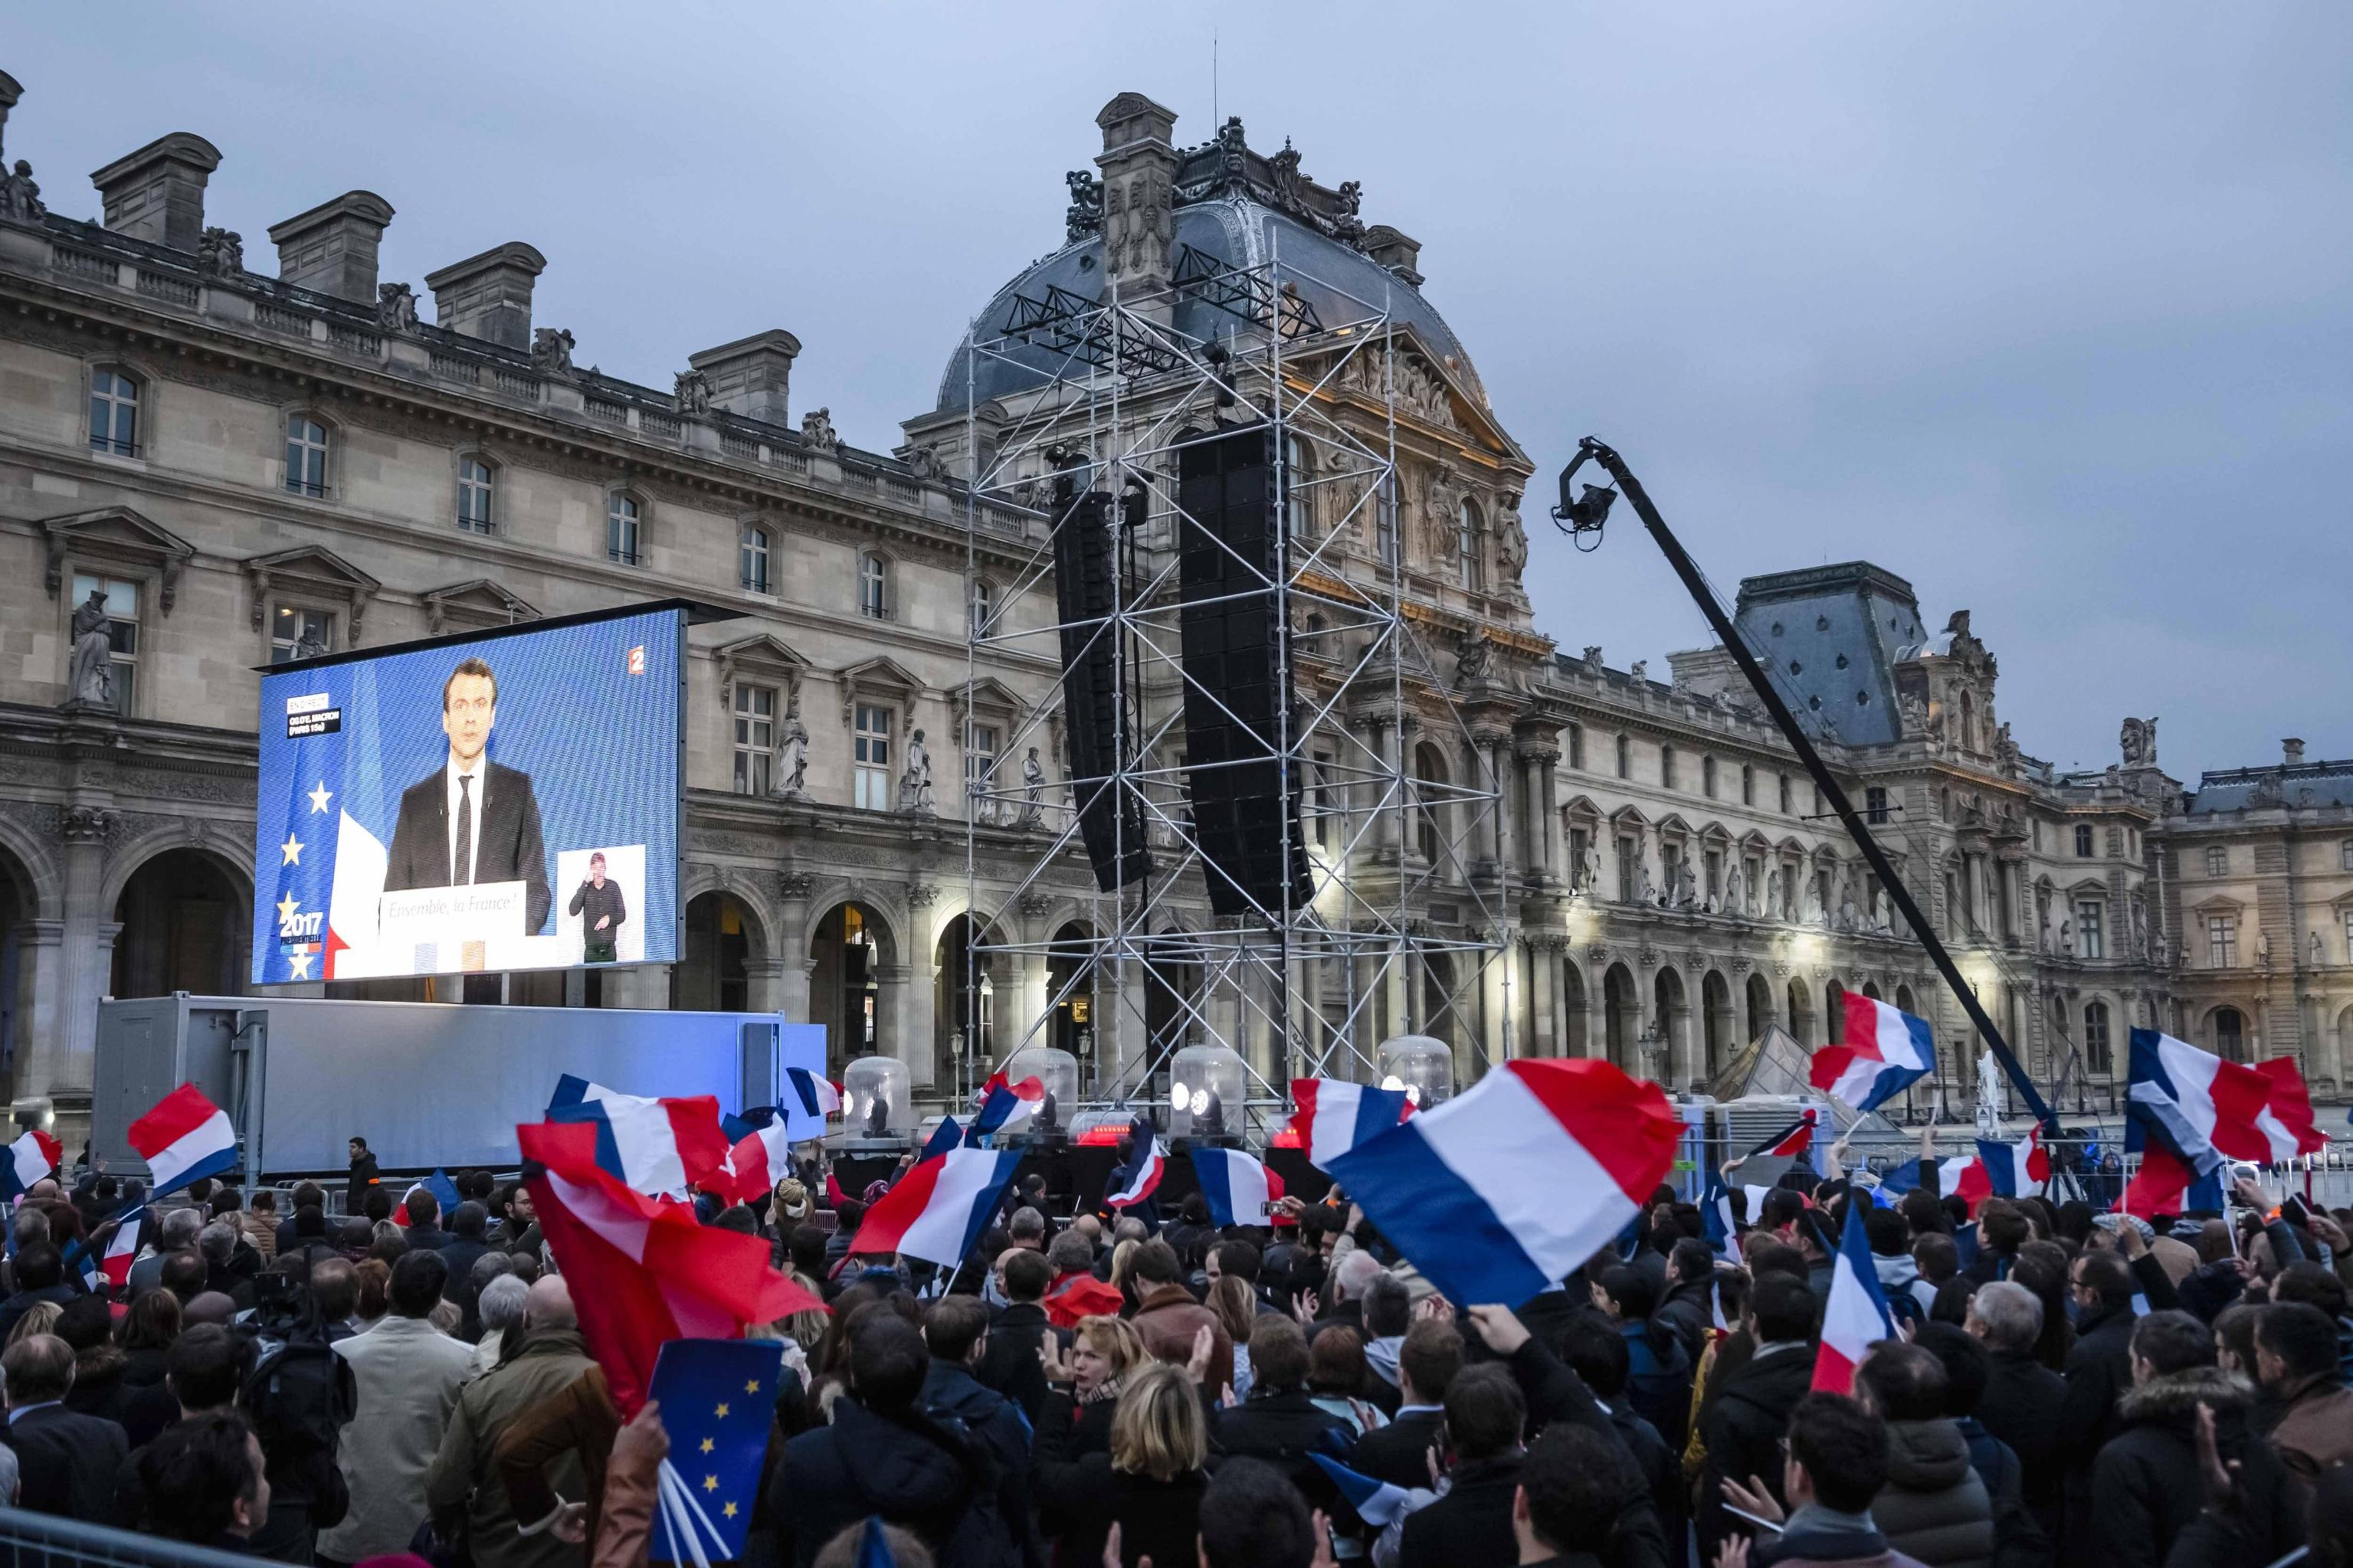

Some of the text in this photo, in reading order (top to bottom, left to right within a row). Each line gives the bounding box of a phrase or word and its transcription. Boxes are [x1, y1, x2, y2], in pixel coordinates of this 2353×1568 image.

[632, 651, 644, 671] 2
[388, 899, 450, 918] Ensemble,
[280, 912, 323, 937] 2017
